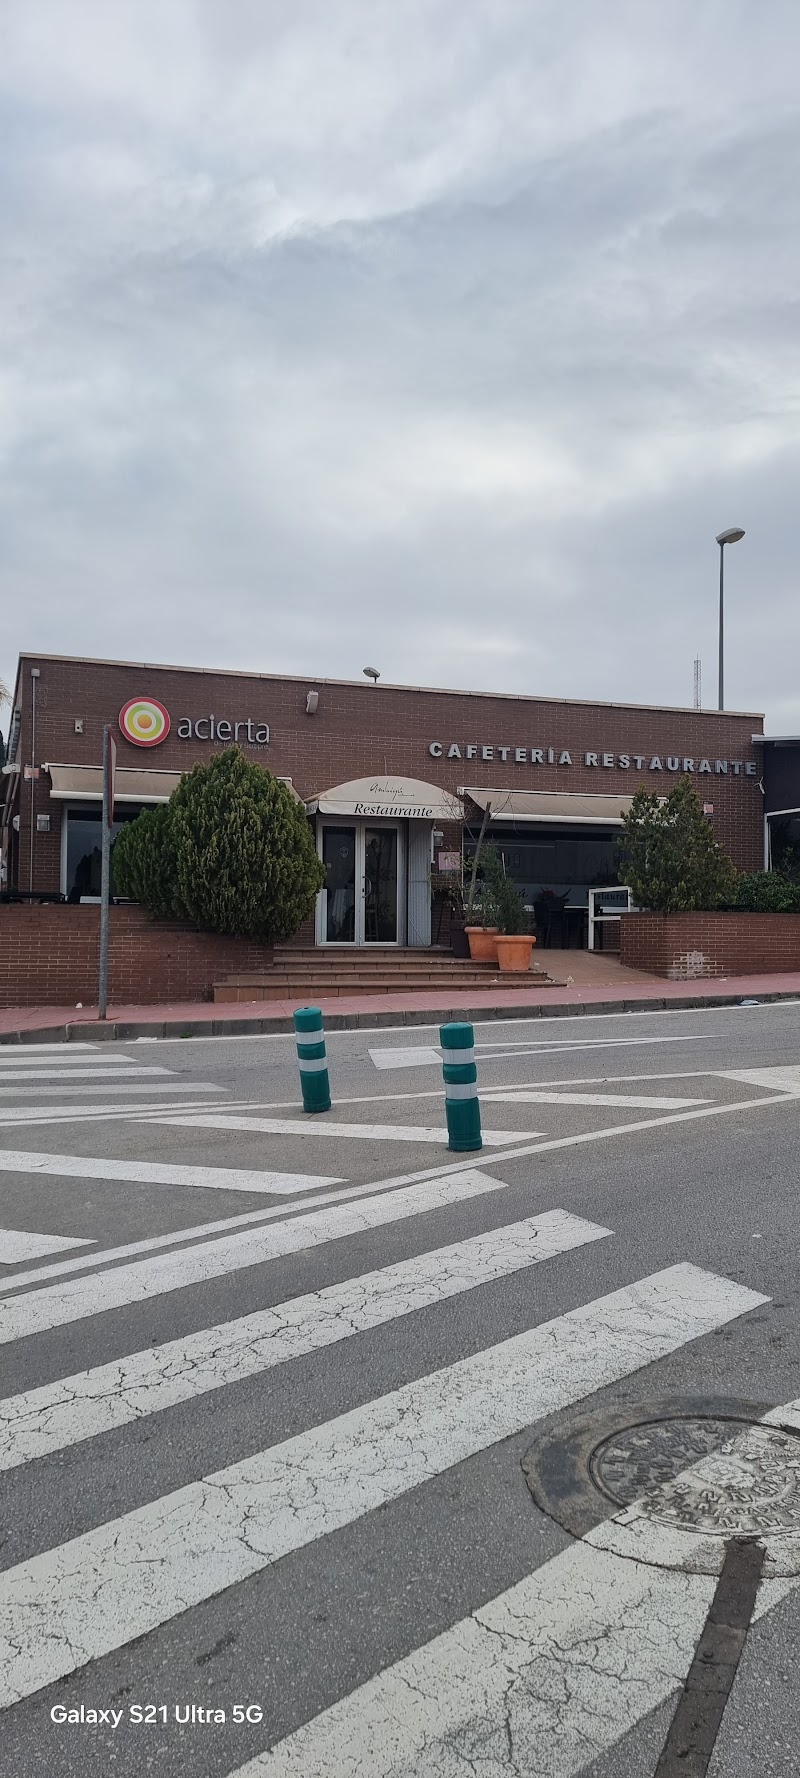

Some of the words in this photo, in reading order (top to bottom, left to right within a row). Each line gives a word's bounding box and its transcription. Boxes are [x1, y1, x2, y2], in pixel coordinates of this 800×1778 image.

[177, 713, 270, 743] acierta
[429, 742, 573, 765] CAFETERÍA
[585, 752, 757, 776] RESTAURANTE
[354, 803, 433, 817] Restaurante
